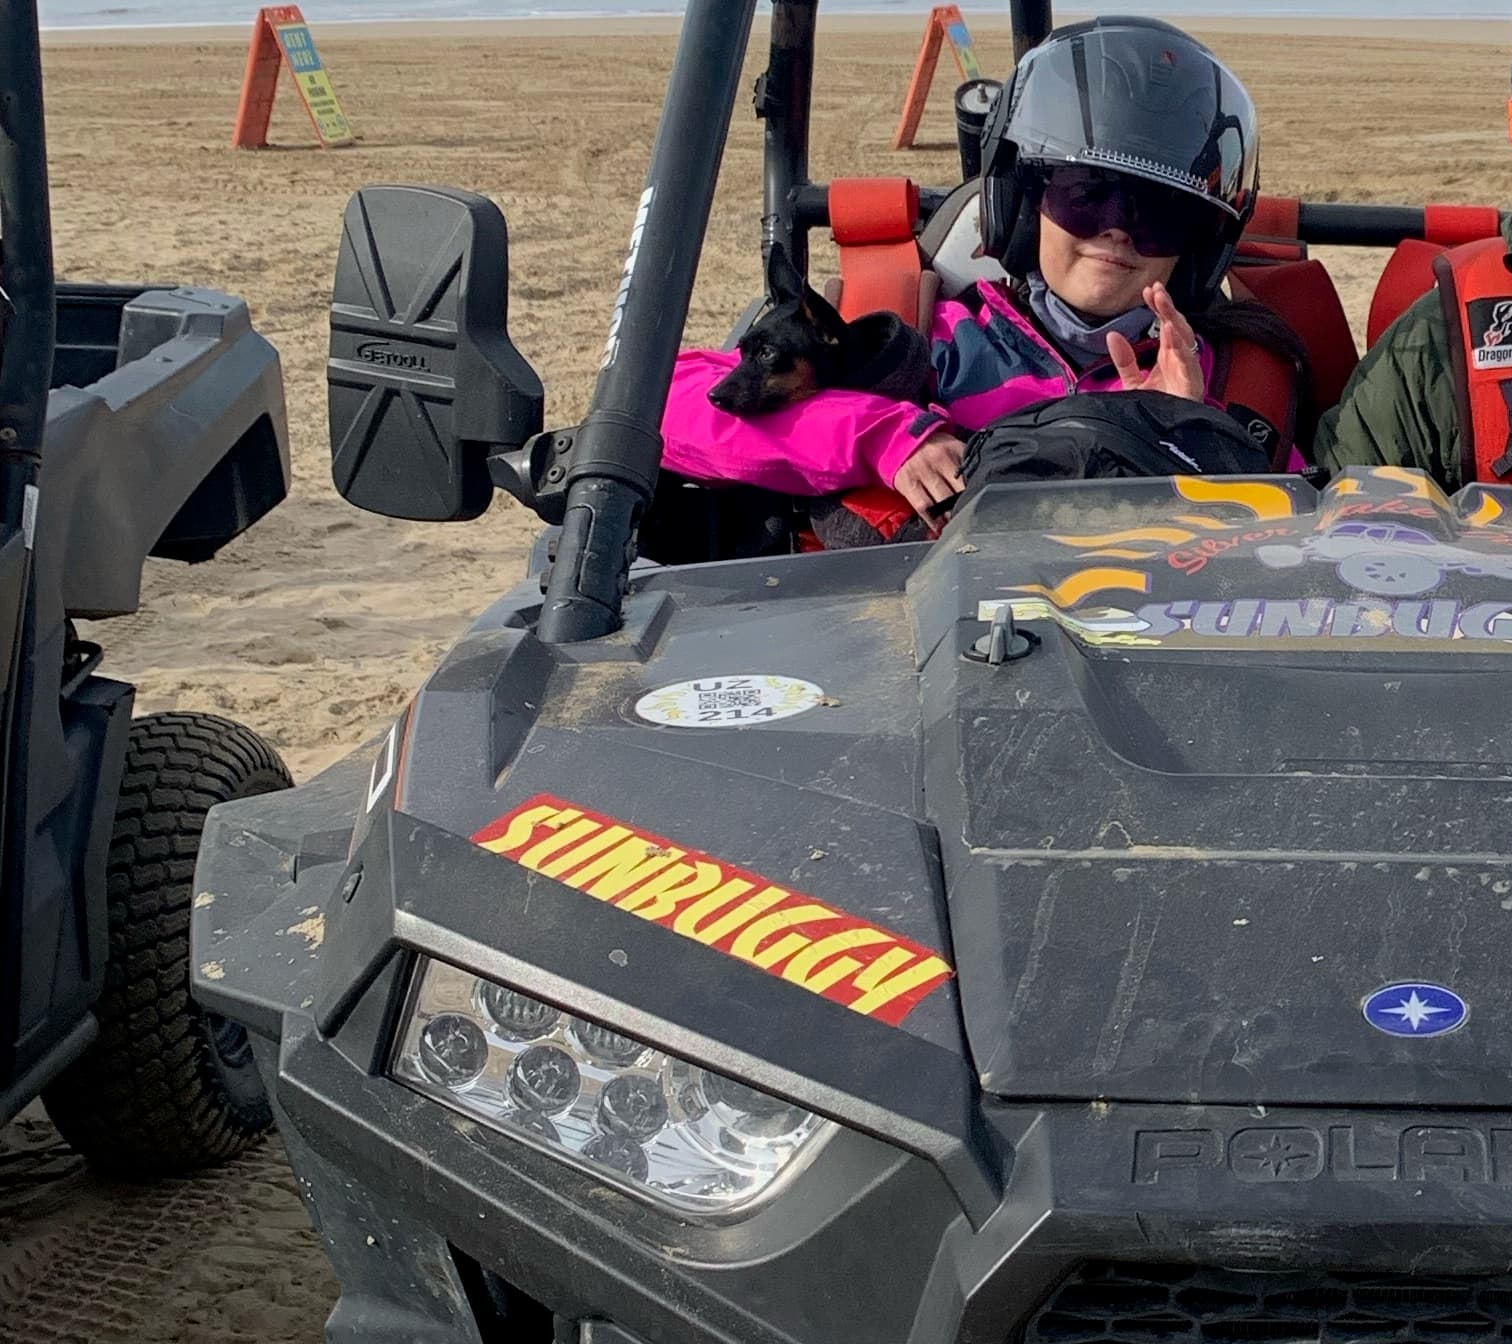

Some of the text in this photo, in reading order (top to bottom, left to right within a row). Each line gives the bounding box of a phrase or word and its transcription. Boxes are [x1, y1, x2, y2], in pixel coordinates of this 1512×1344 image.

[1168, 526, 1299, 576] Silver
[698, 707, 777, 722] 214
[475, 803, 956, 1015] SUNBUGGY
